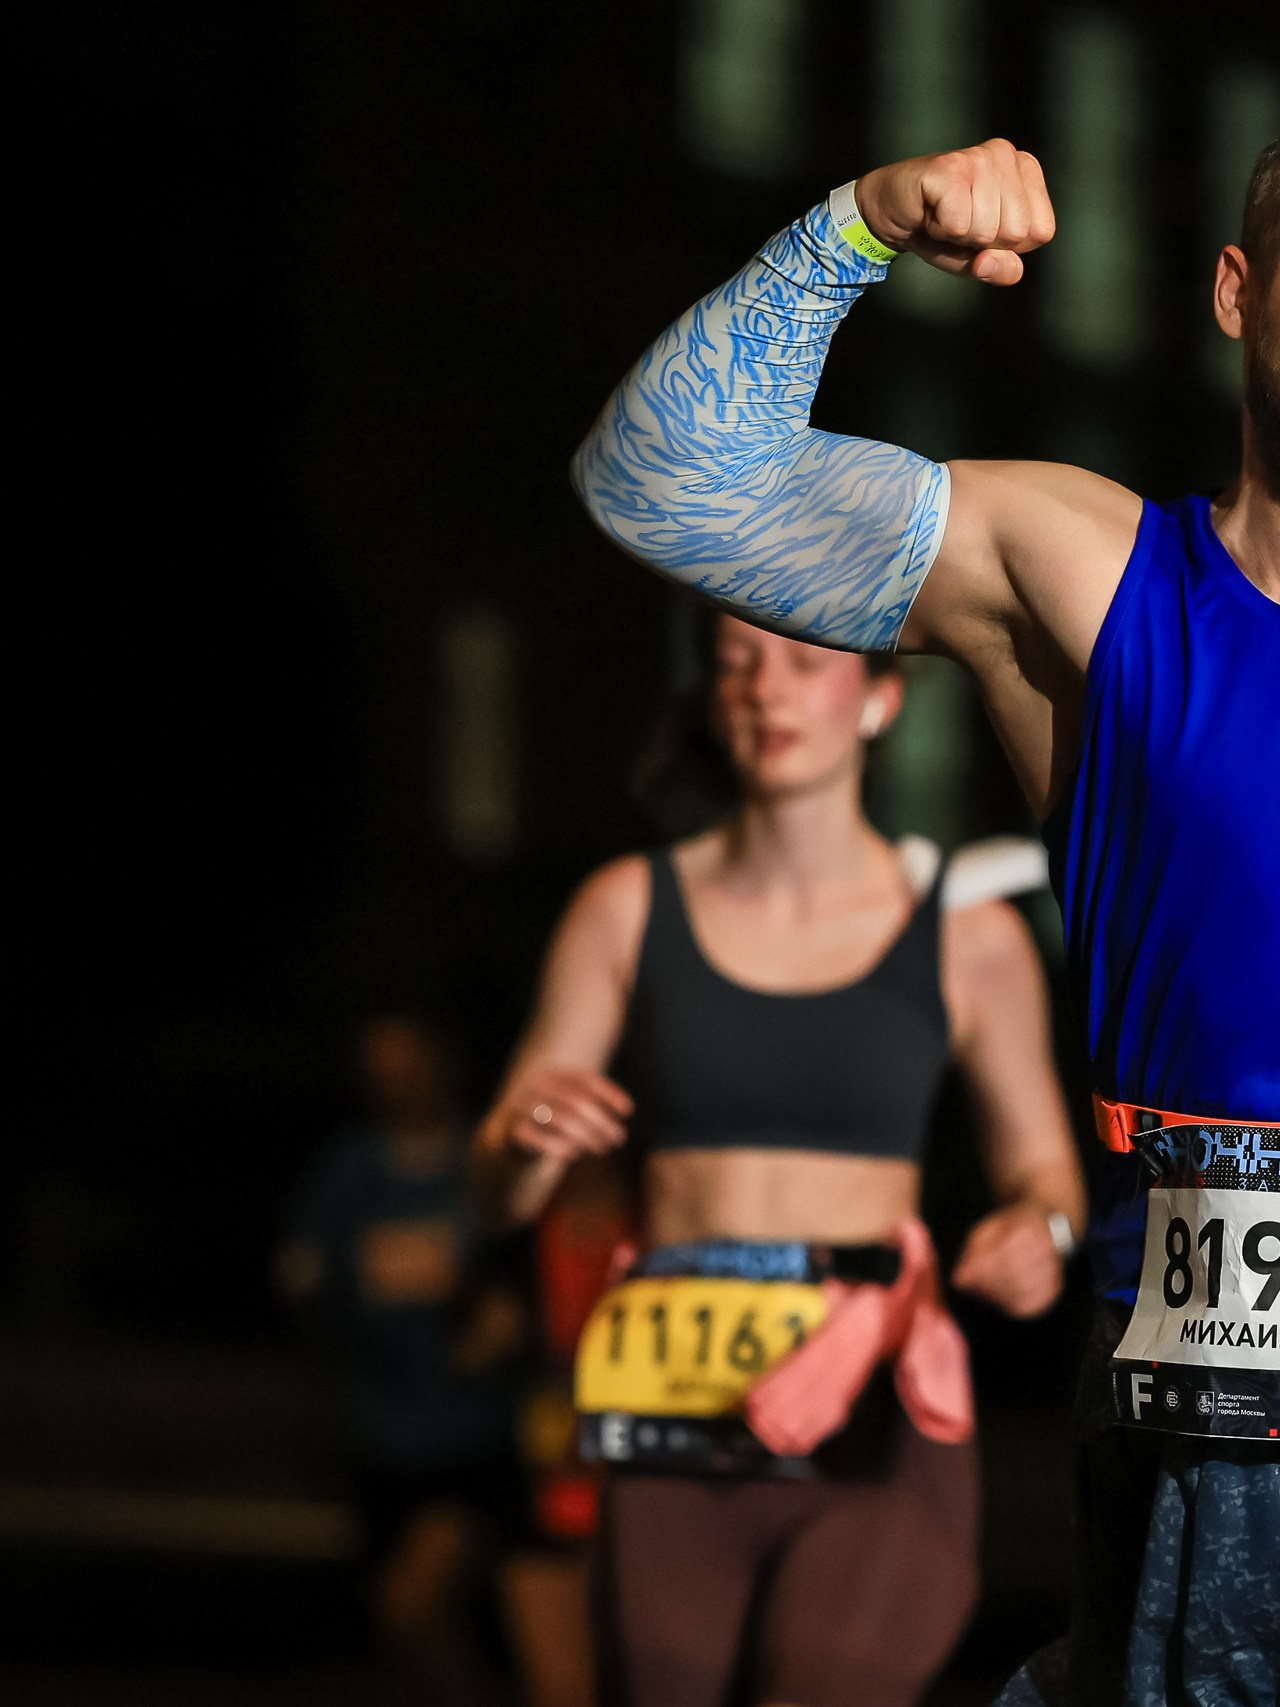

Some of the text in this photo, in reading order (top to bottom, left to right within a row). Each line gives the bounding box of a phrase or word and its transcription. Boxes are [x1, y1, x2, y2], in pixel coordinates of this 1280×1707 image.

[1131, 1373, 1154, 1420] F
[1217, 1392, 1260, 1401] Департамент
[1217, 1409, 1266, 1417] города Москвы
